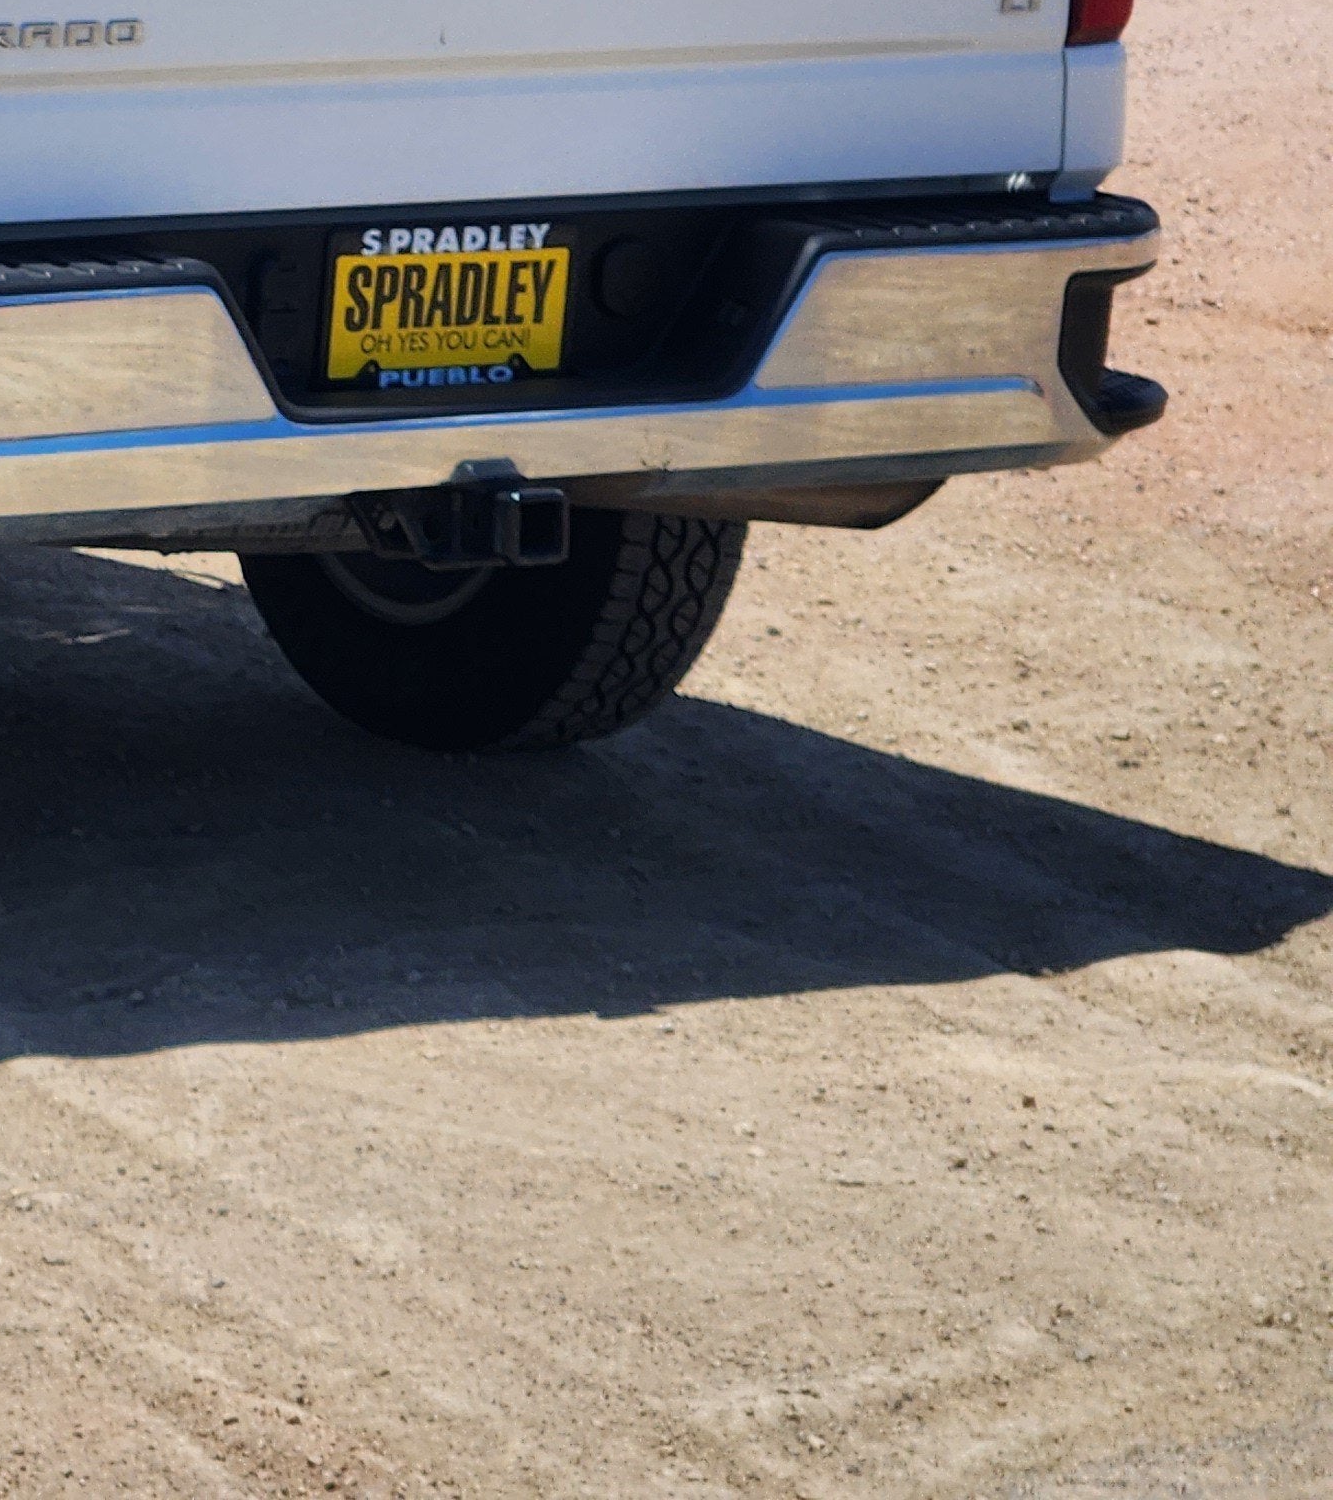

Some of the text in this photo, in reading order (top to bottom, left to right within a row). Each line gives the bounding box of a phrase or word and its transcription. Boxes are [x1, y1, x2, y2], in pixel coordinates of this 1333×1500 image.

[361, 222, 551, 256] SPRADLEY
[344, 259, 557, 332] SPRADLEY
[361, 334, 391, 353] OH
[399, 332, 429, 352] YES
[436, 330, 477, 350] YOU
[379, 365, 514, 389] PUEBLO
